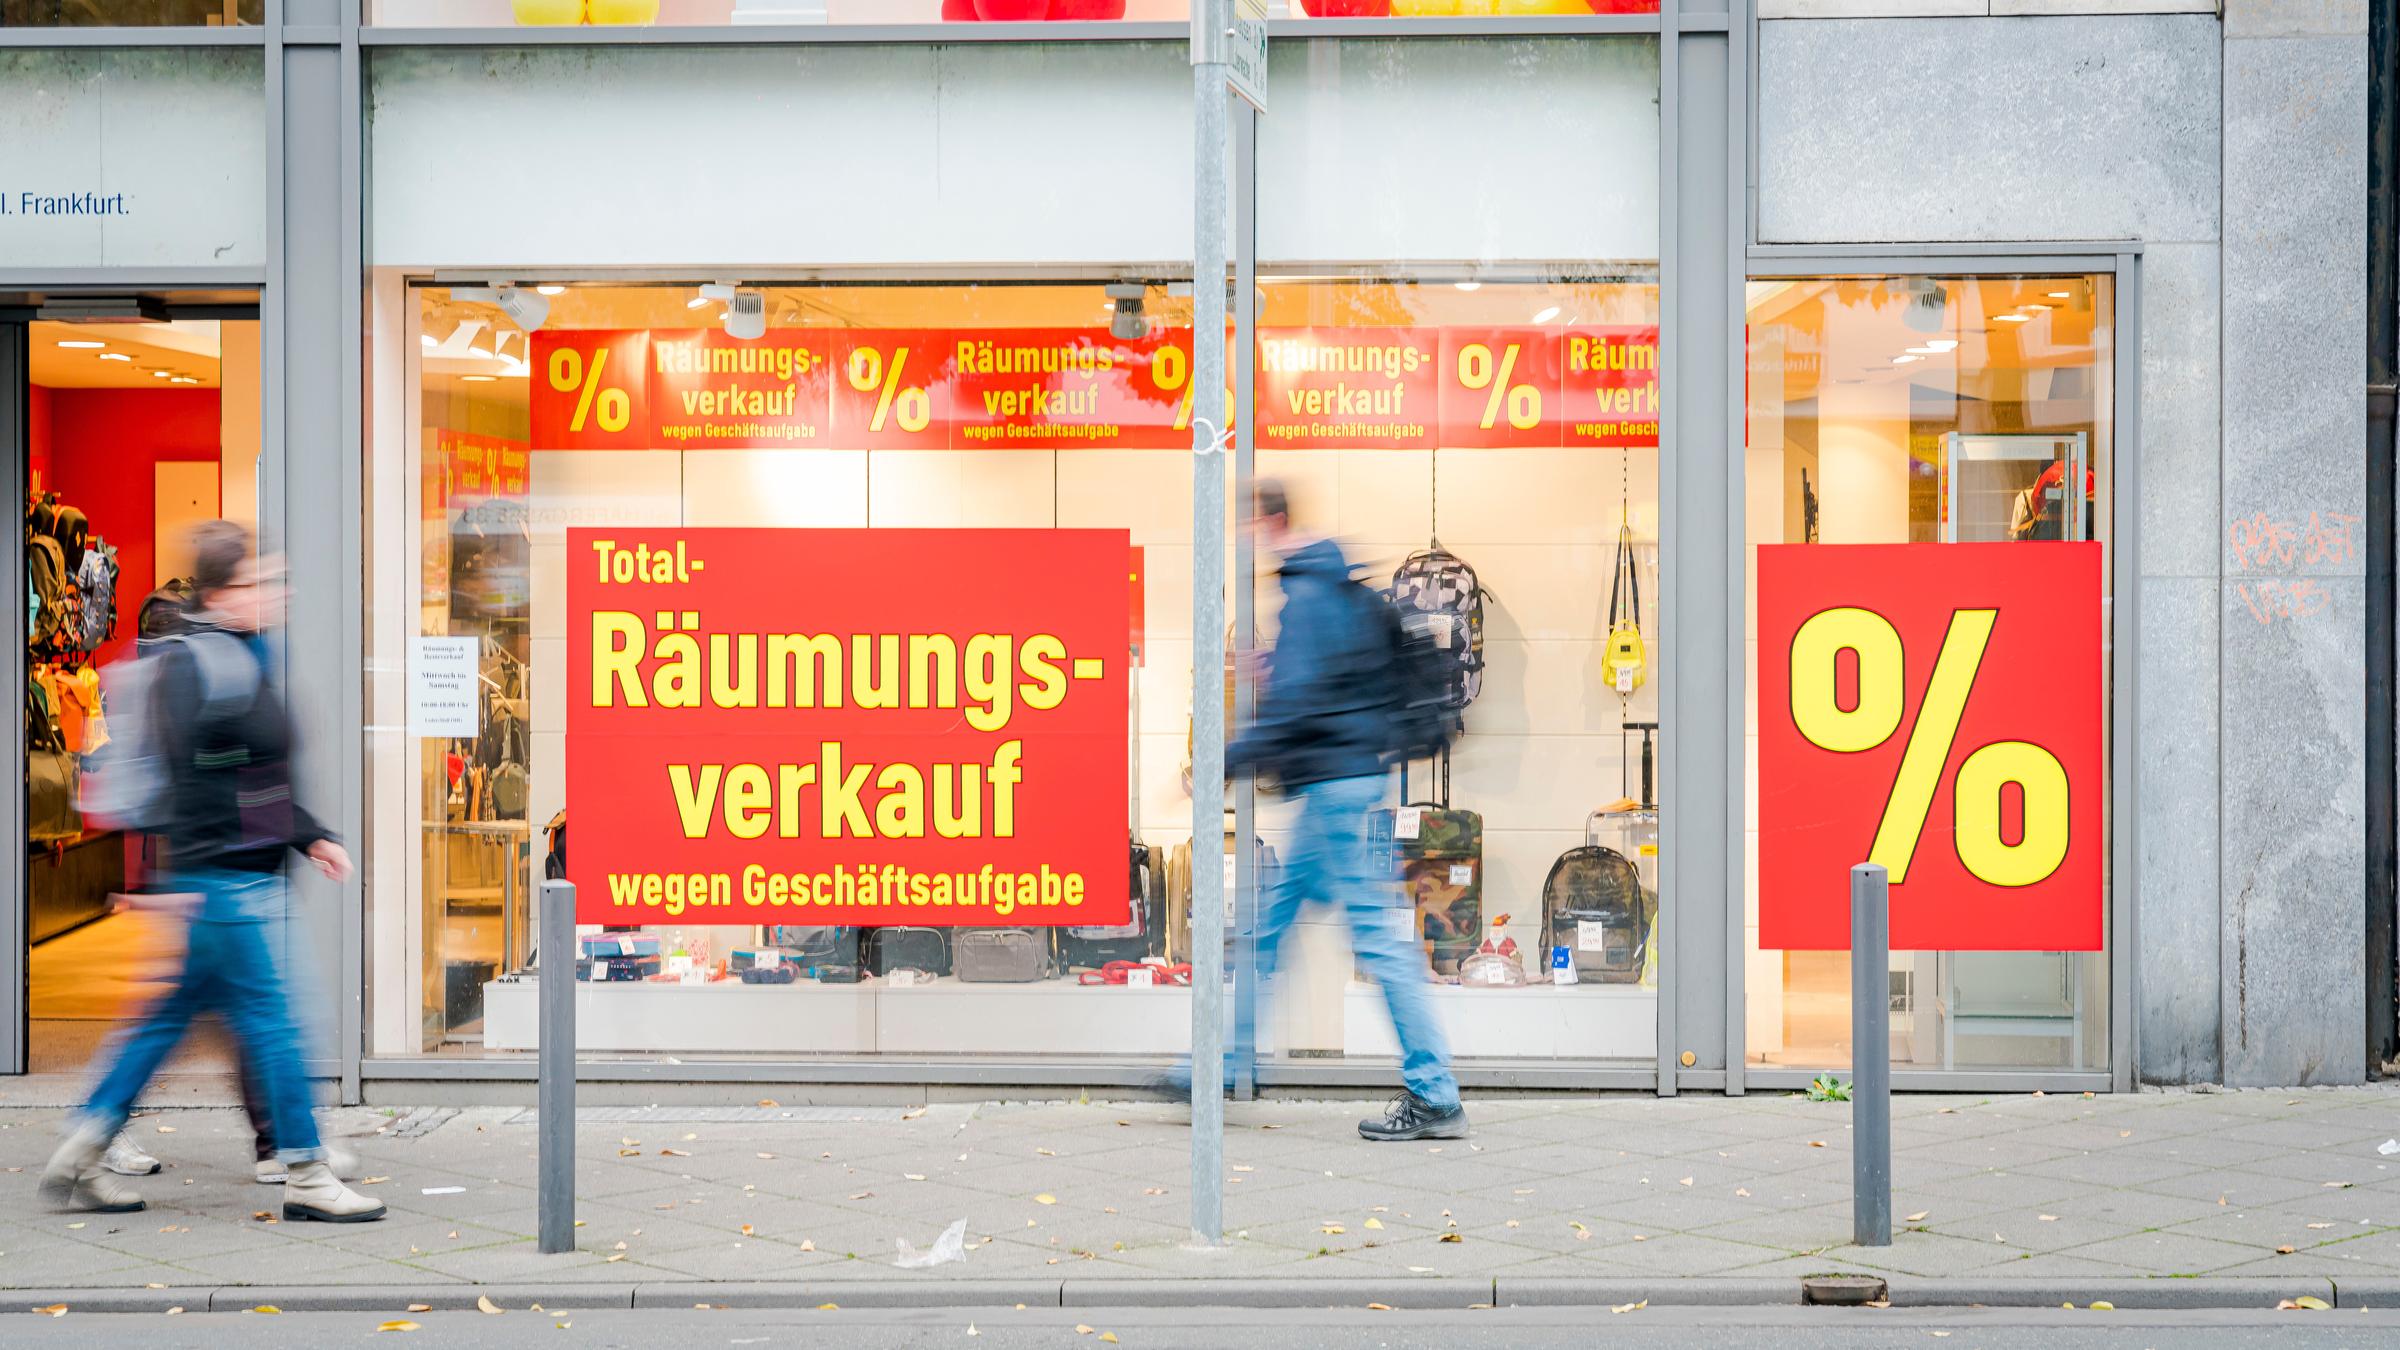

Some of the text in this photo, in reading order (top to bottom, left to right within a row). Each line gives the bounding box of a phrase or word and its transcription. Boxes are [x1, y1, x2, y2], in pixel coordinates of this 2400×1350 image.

[21, 192, 130, 215] Frankfurt.
[656, 341, 822, 380] Räumungs-
[957, 340, 1124, 379] Räumungs-
[1261, 339, 1431, 379] Räumungs-
[548, 347, 631, 433] %
[681, 383, 797, 416] verkauf
[848, 346, 930, 433] %
[983, 382, 1099, 416] verkauf
[1287, 382, 1404, 416] verkauf
[1457, 343, 1542, 430] %
[662, 422, 816, 440] wegen Geschäftsaufgabe
[963, 423, 1119, 441] wegen Geschäftsaufgabe
[1267, 422, 1424, 440] wegen Geschäftsaufgabe
[1575, 424, 1617, 439] wegen
[592, 540, 707, 585] Total-
[592, 611, 1105, 734] Räumungs-
[1789, 606, 2071, 888] %
[668, 740, 1024, 841] verkauf
[608, 863, 1087, 917] wegen Geschäftsaufgabe
